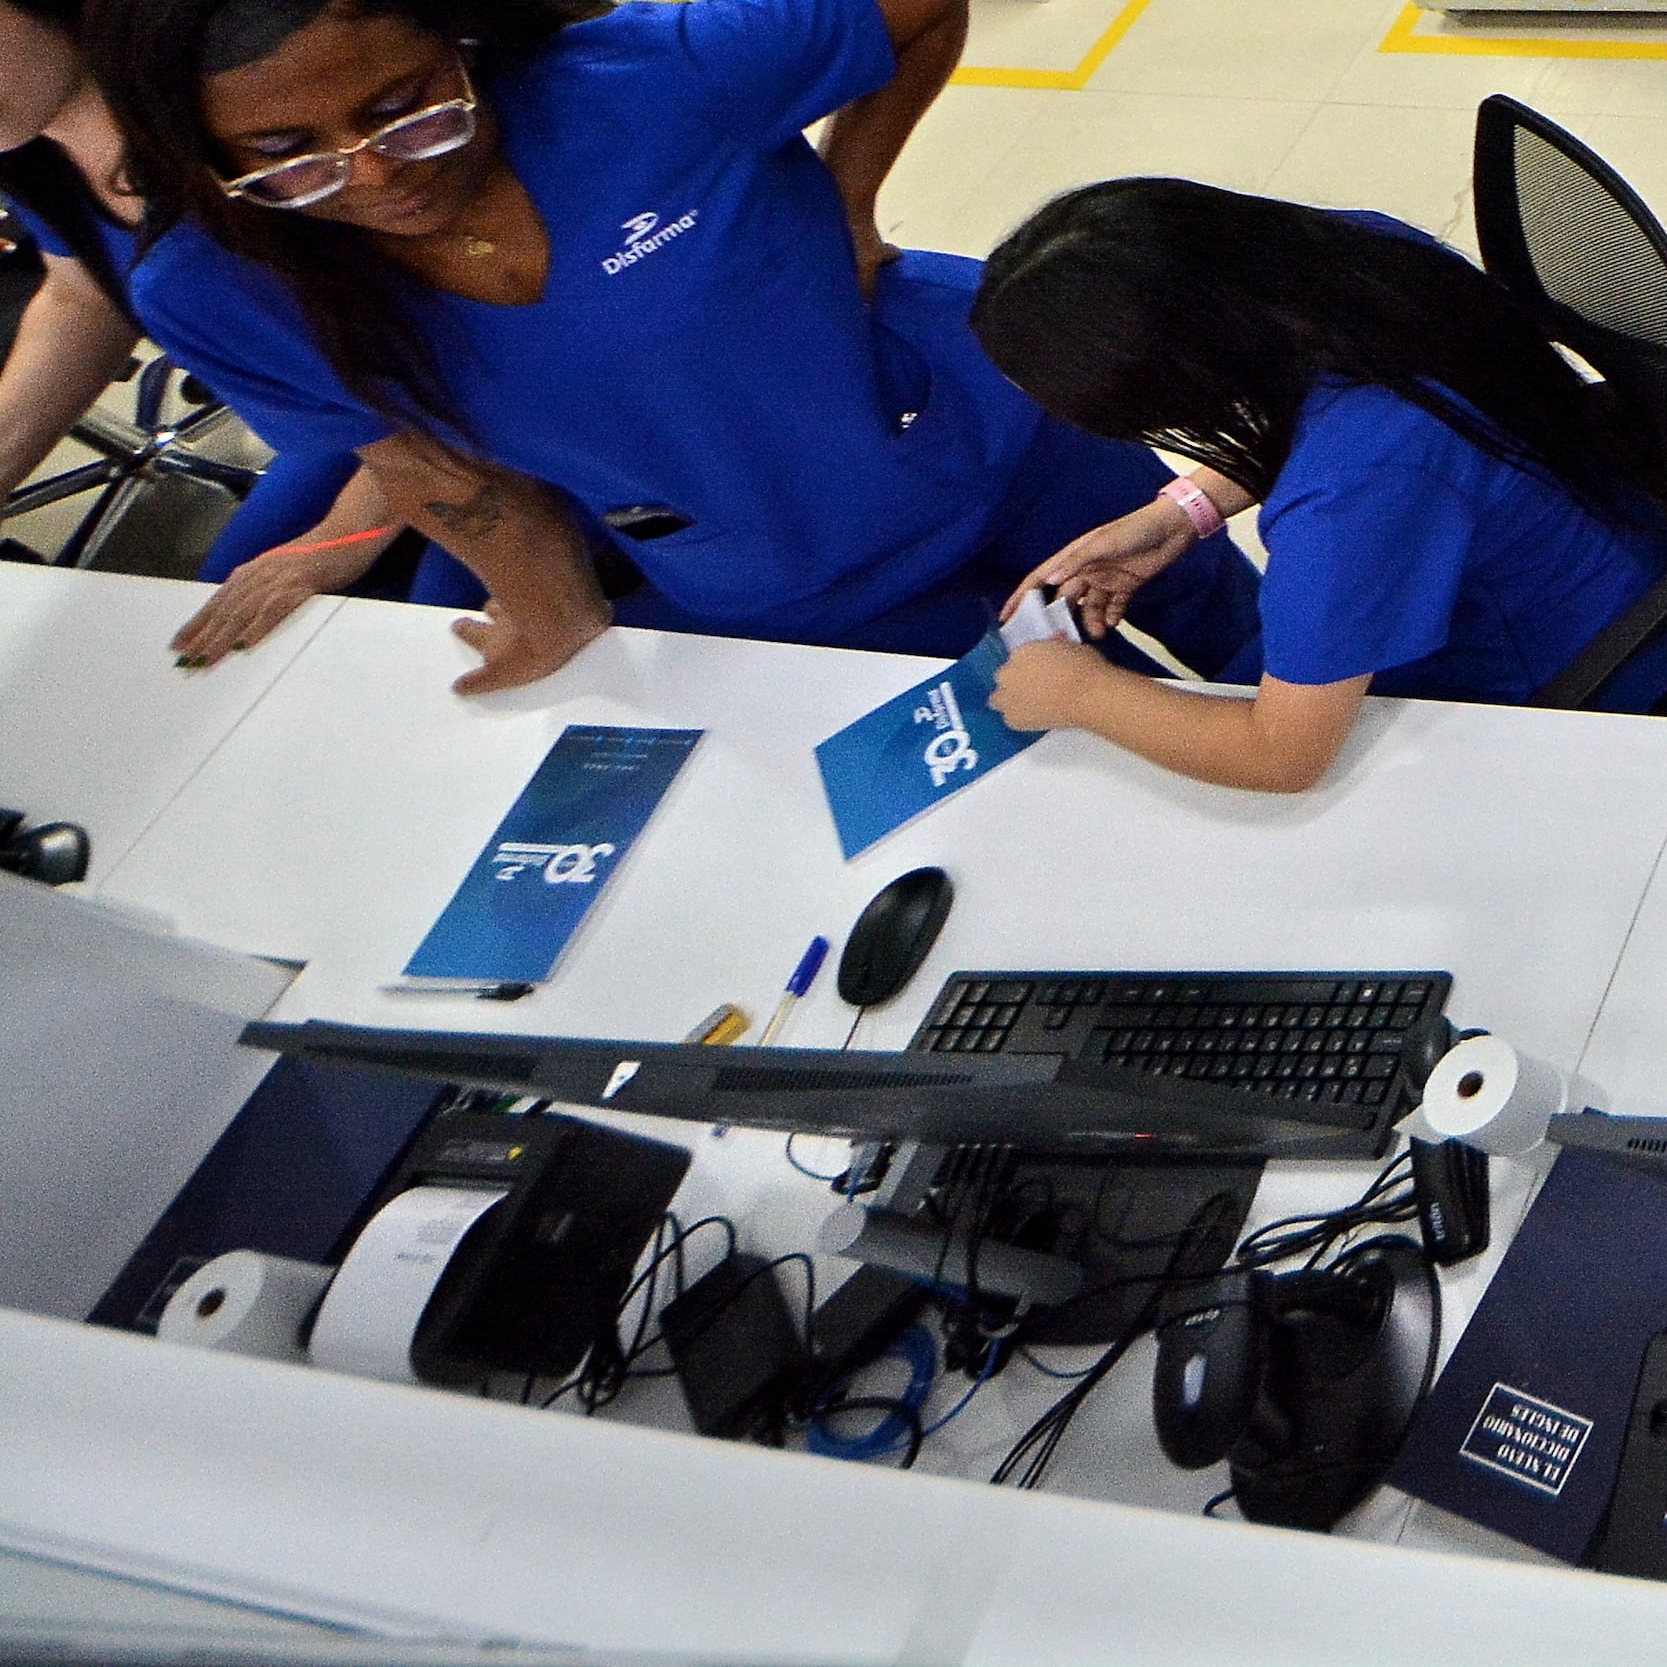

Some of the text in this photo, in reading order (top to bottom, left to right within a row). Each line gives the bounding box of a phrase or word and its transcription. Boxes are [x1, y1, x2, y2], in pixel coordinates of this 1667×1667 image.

[601, 213, 695, 275] Disfarma
[1482, 1414, 1571, 1461] DICCIONARIO
[1558, 1423, 1580, 1443] DE
[1497, 1442, 1562, 1482] EL NUEVO
